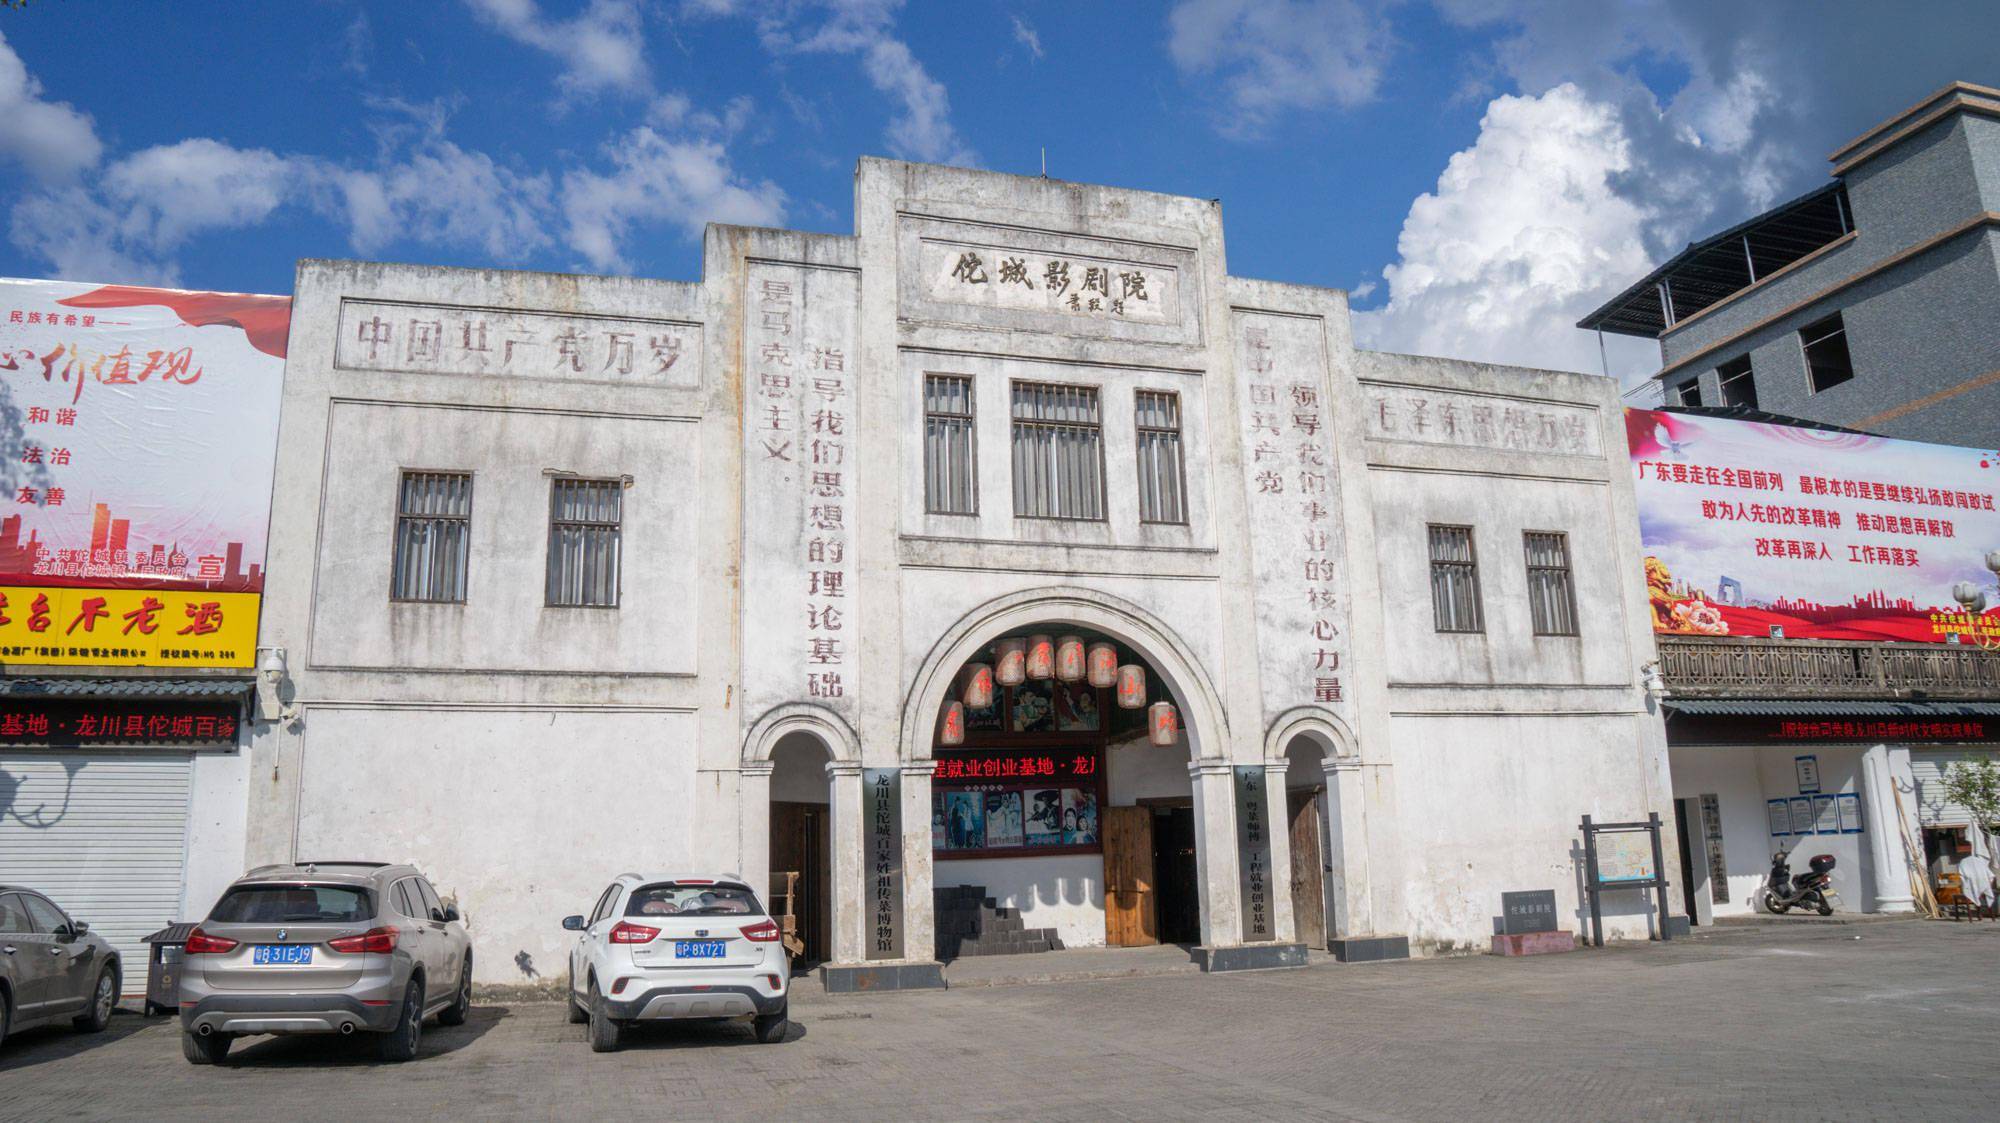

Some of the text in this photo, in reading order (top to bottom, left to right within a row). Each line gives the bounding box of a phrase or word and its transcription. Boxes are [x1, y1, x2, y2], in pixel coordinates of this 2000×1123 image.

[951, 252, 1149, 301] 佗城影剧院
[358, 316, 682, 374] 中国共产党万岁
[28, 407, 77, 426] 和谐
[22, 447, 72, 465] 法治
[17, 487, 65, 506] 友善
[1639, 460, 1996, 512] 广东要走在全国前列 最根本的是要继续弘扬敢闯敢试
[808, 346, 846, 698] 指导我们思想的理论基础
[1702, 500, 1955, 538] 敢为人先的改革精神 推动思想再解放
[1290, 384, 1344, 703] 领导我们事业的核心力量
[1755, 538, 1919, 567] 改革再深入 工作再落实
[197, 554, 225, 581] 宣
[875, 774, 892, 951] 龙川县佗城百家姓祖传菜博物馆
